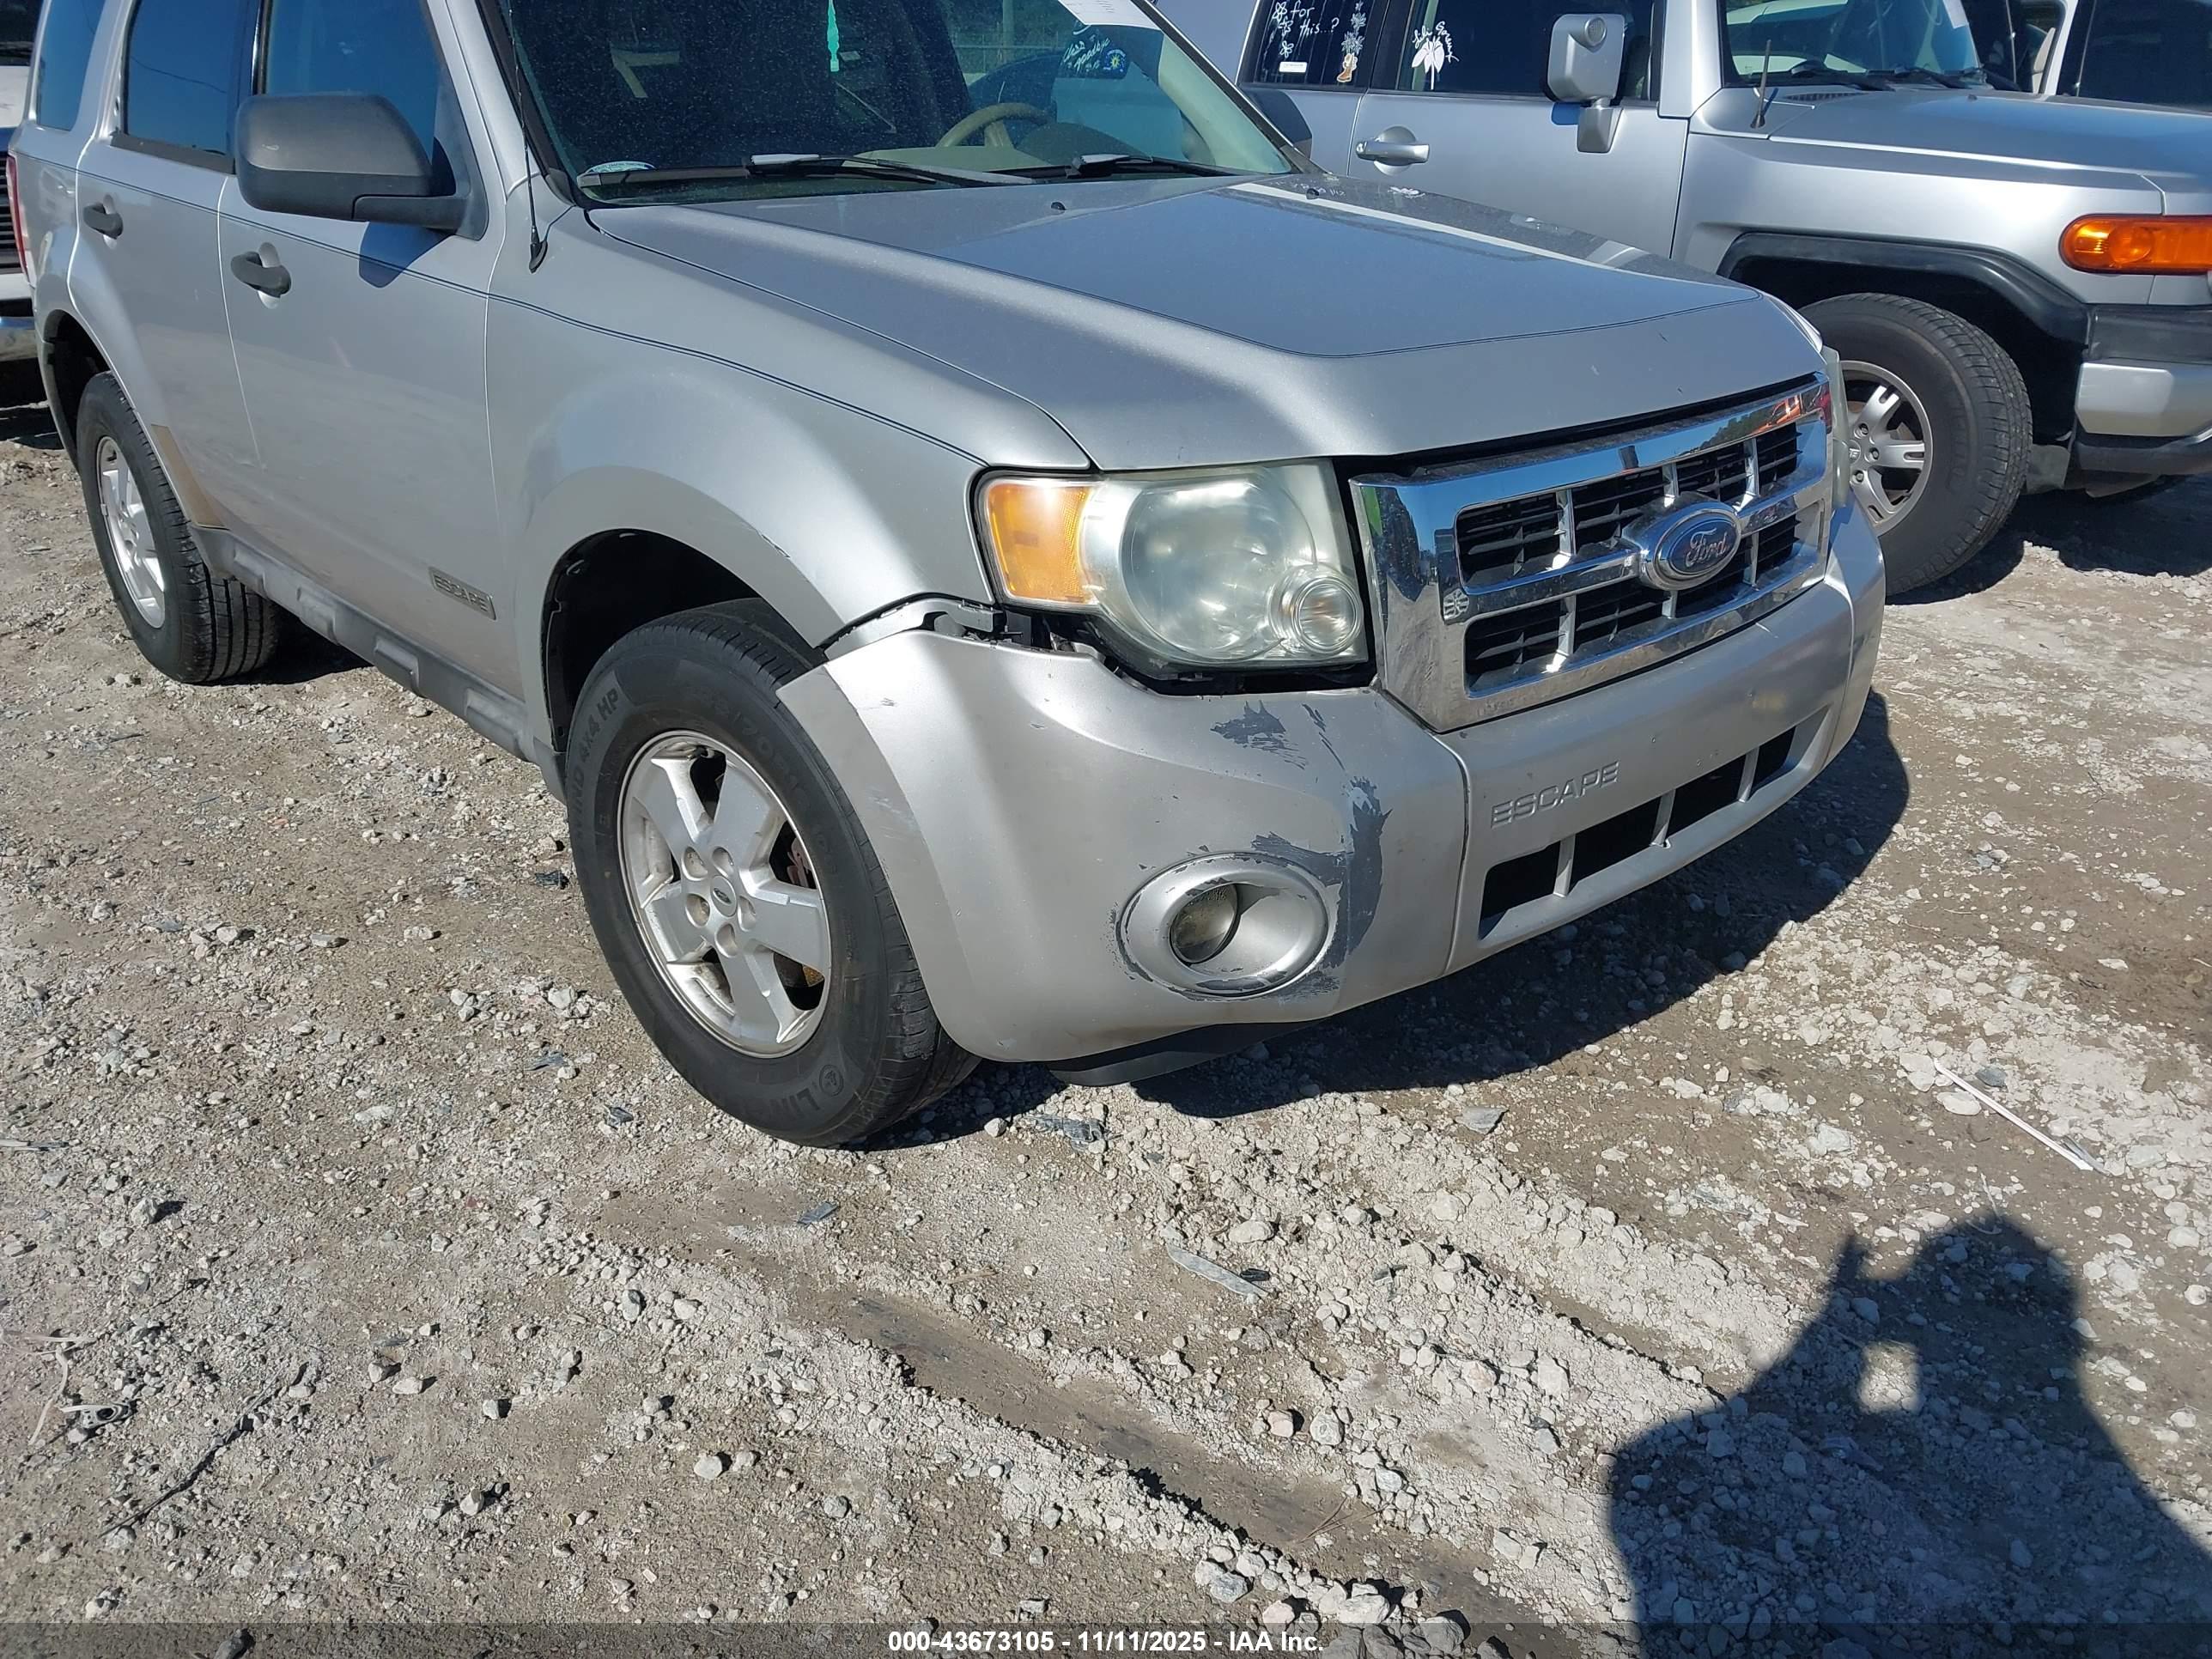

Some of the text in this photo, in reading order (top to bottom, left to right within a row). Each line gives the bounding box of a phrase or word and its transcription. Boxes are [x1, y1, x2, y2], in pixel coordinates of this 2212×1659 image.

[1290, 0, 1316, 21] for
[1685, 527, 1729, 568] Ford
[432, 574, 489, 612] ESCAPE
[596, 687, 619, 720] HP
[1491, 761, 1620, 830] ESCAPE
